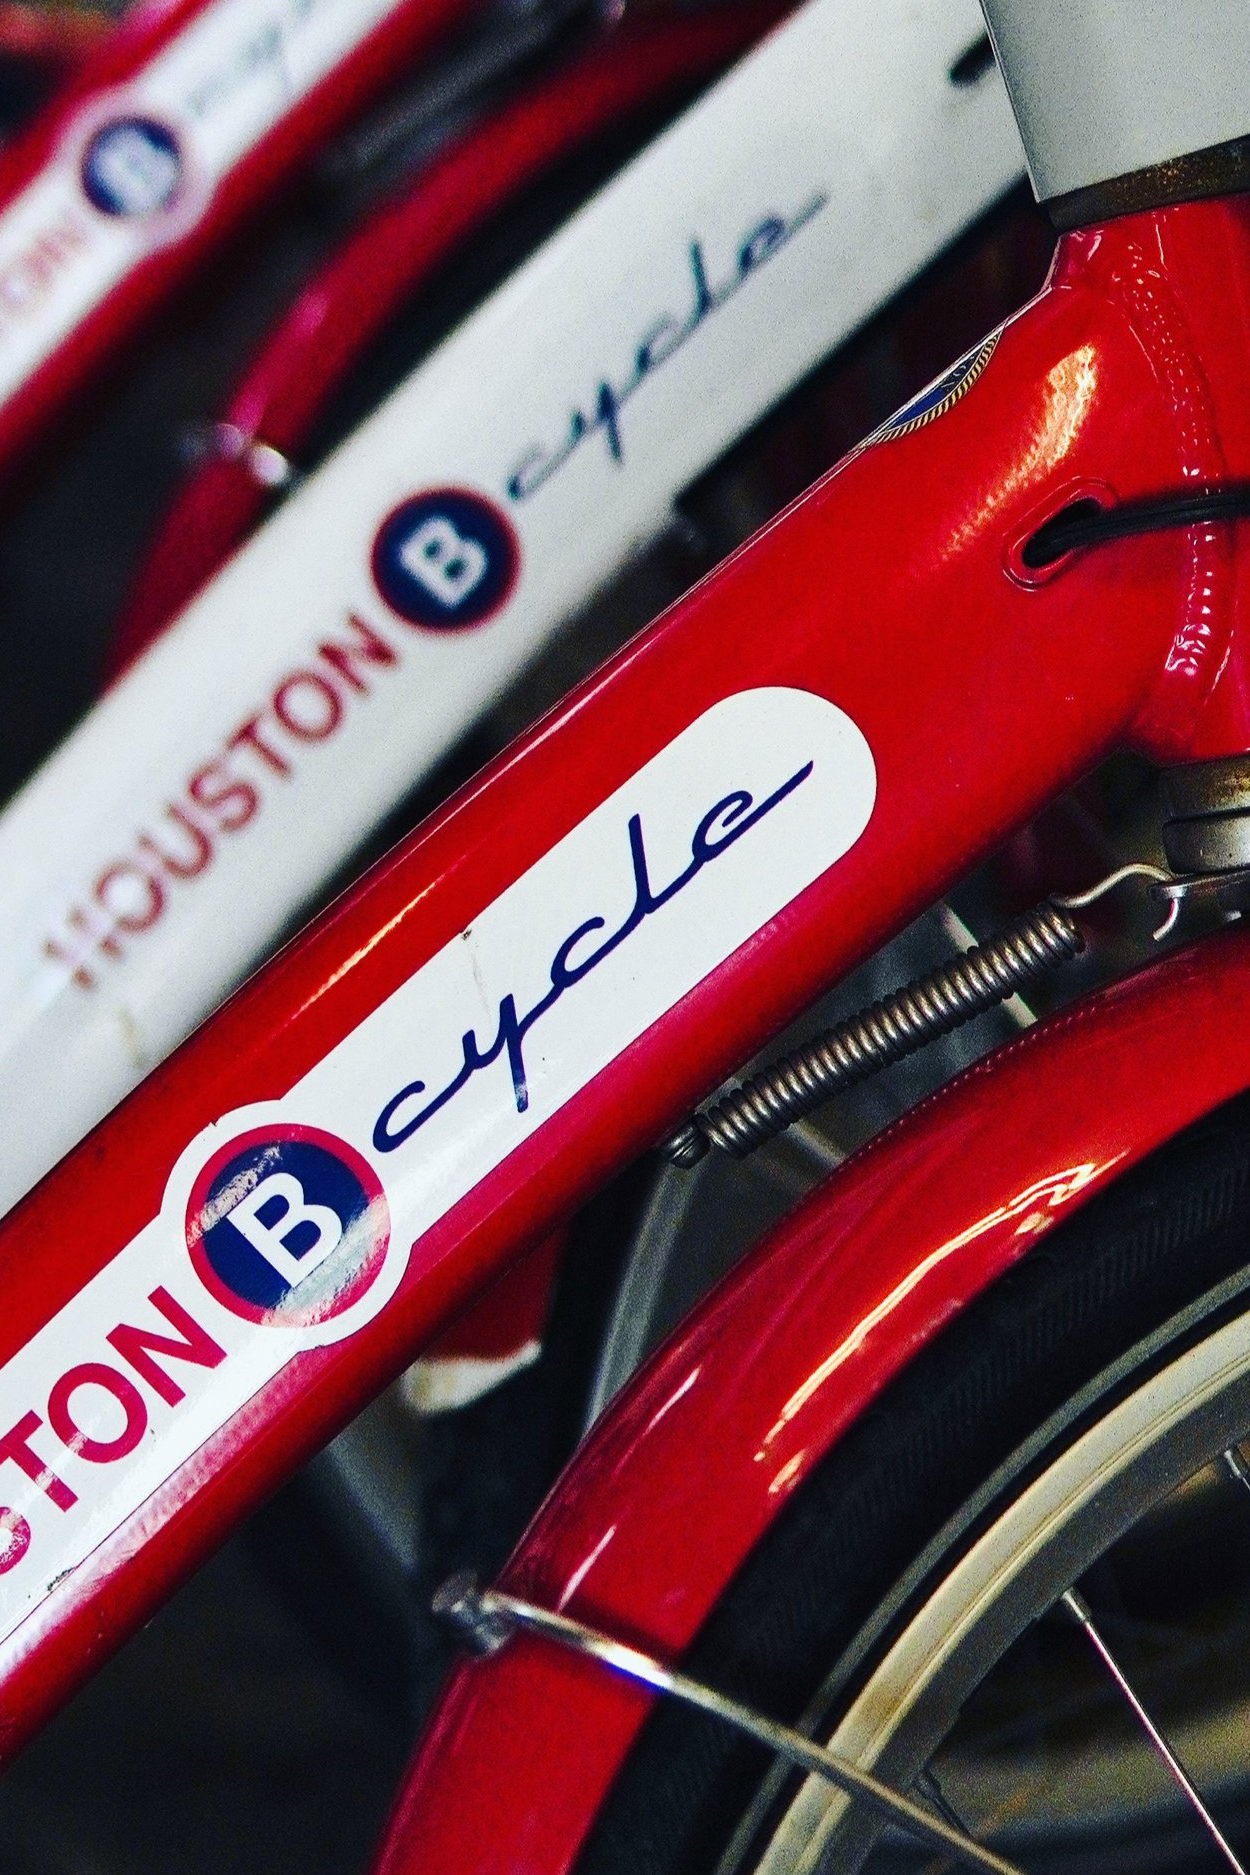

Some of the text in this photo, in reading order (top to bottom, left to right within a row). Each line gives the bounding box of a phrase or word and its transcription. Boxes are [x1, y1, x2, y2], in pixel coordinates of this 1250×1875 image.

[40, 188, 832, 990] HOUSTON B cycle
[226, 1171, 343, 1288] B
[372, 760, 814, 1153] cycle
